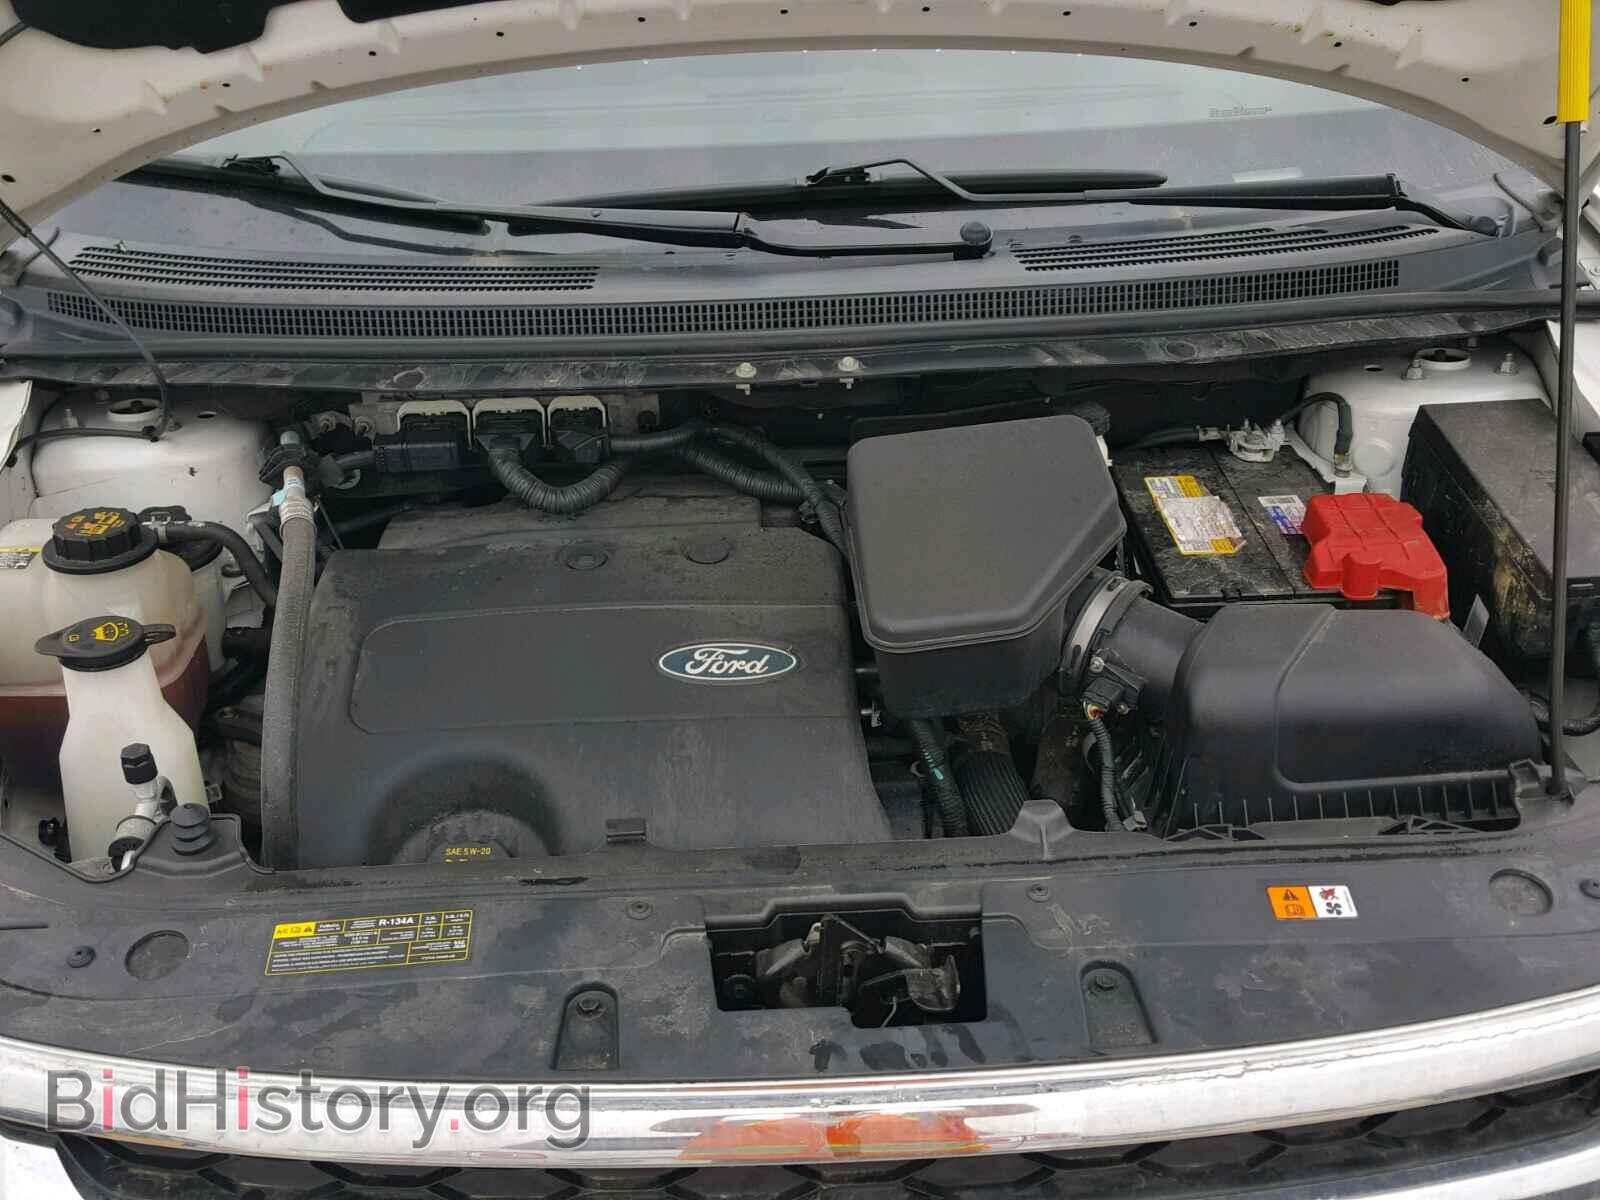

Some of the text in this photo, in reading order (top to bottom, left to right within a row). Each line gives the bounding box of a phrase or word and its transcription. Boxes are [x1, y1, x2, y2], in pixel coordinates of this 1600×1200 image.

[685, 647, 770, 675] Ford
[445, 847, 463, 856] SAE
[378, 916, 415, 927] R-134A
